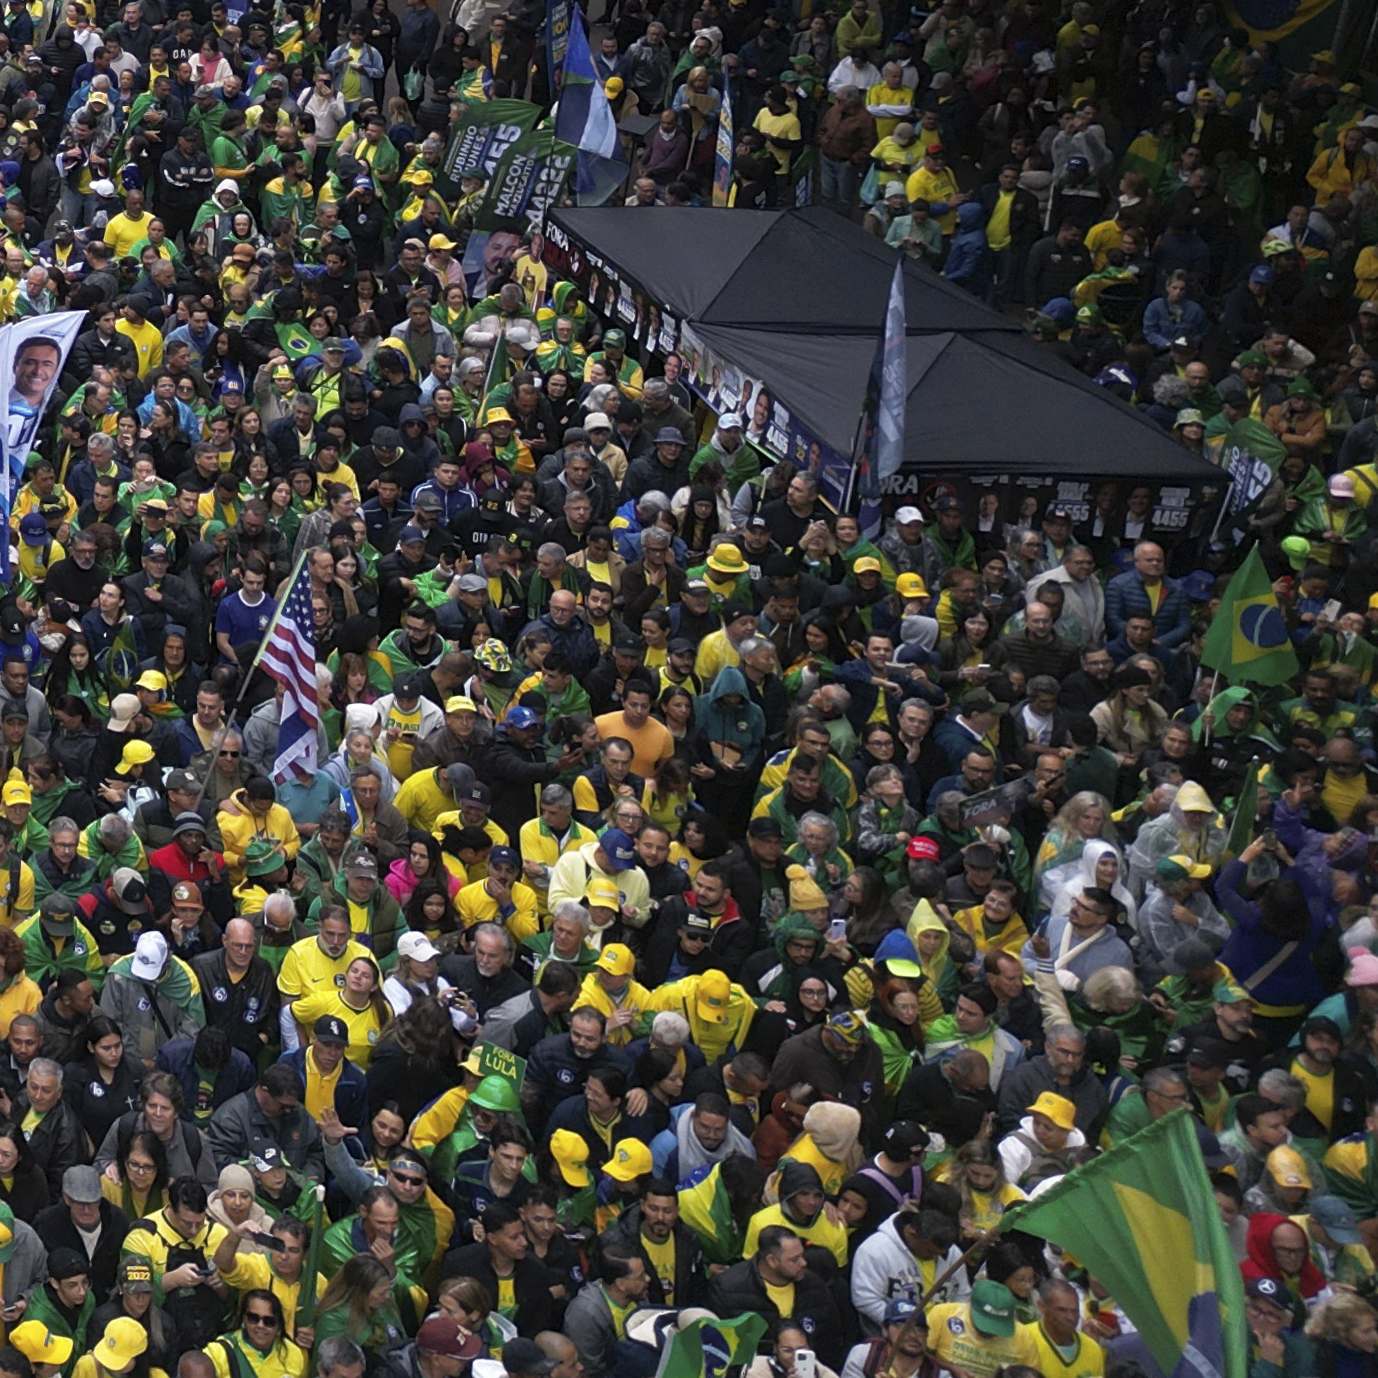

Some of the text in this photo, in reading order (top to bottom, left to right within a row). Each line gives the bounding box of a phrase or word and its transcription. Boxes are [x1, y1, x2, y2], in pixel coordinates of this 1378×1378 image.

[450, 126, 477, 182] RUBINHO
[494, 154, 527, 217] MALCON
[545, 221, 569, 252] FORA
[965, 798, 996, 818] FORA
[486, 1054, 517, 1080] LULA
[493, 1046, 516, 1064] FORA
